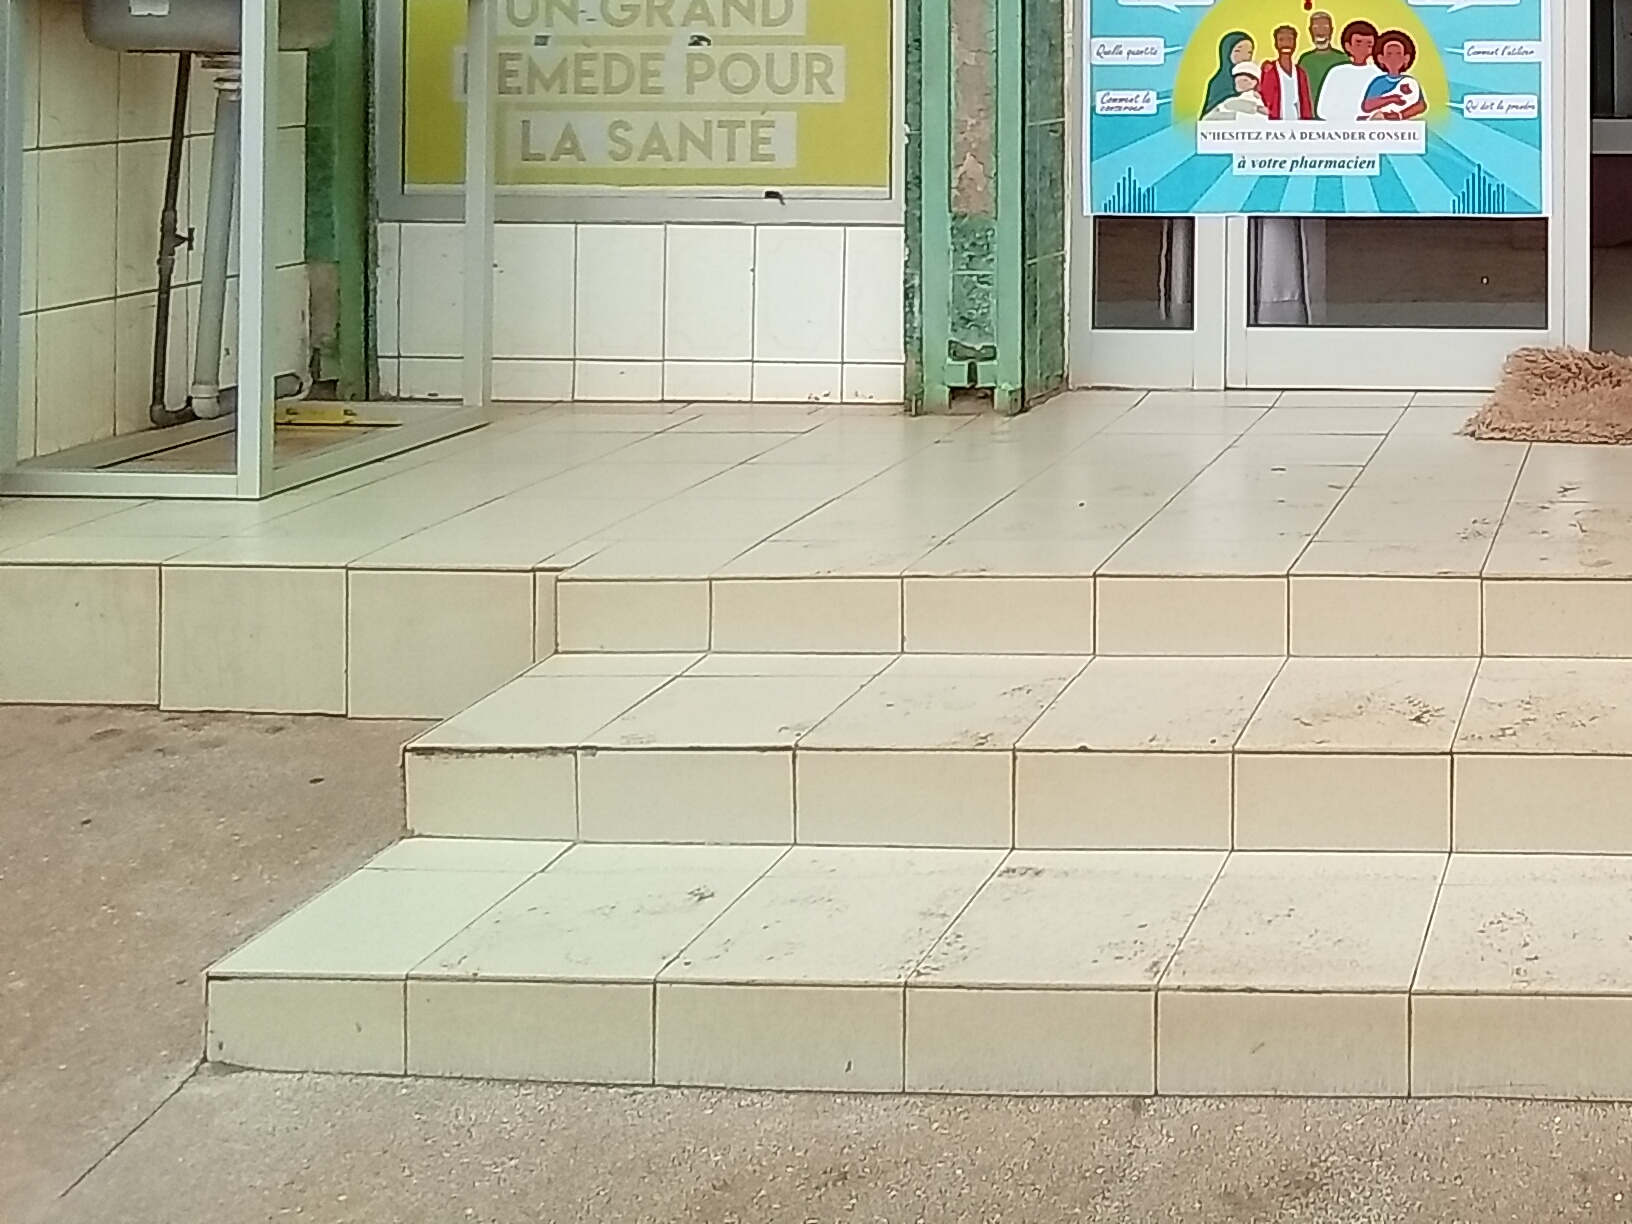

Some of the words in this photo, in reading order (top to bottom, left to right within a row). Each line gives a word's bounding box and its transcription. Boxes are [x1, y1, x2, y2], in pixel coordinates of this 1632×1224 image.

[463, 36, 666, 95] EMÈDE
[686, 52, 836, 95] POUR
[520, 119, 587, 163] LA
[607, 110, 777, 163] SANTÉ
[1265, 130, 1287, 141] PAS
[1300, 130, 1366, 141] DEMANDER
[1368, 130, 1420, 141] CONSEIL
[1237, 155, 1247, 170] à
[1251, 158, 1287, 170] votre
[1289, 155, 1377, 173] pharmacien
